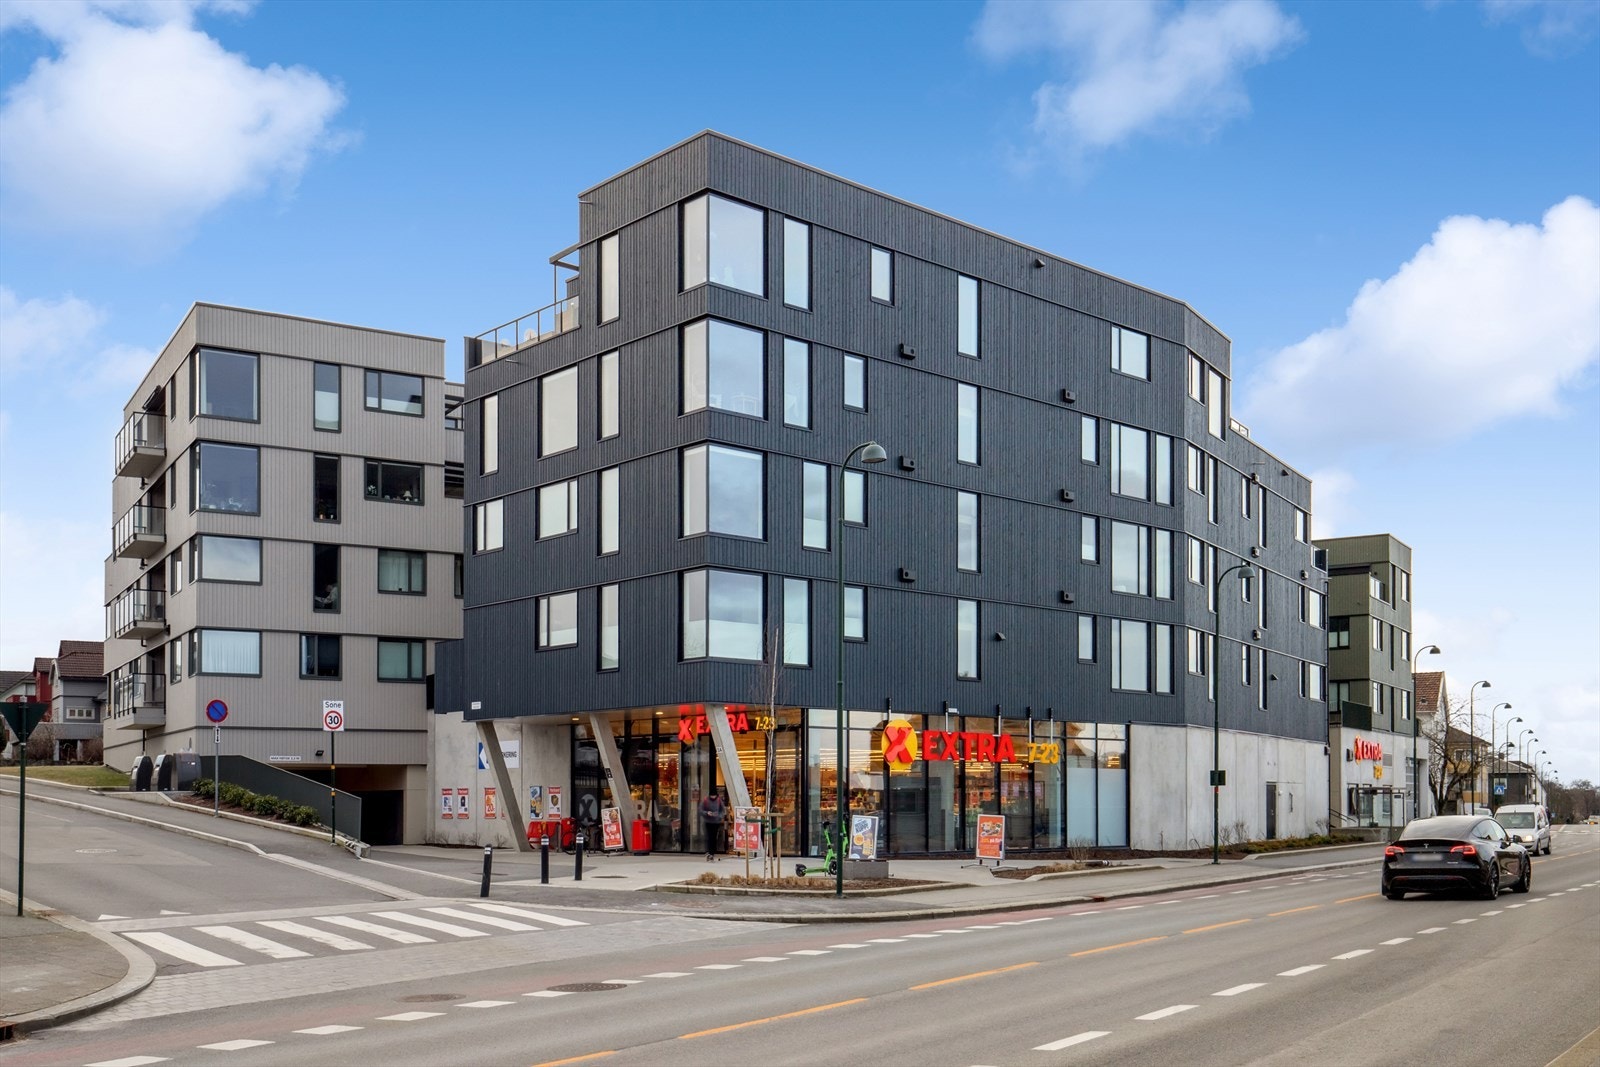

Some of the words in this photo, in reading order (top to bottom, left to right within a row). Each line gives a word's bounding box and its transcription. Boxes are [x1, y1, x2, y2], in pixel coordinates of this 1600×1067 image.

[328, 715, 339, 725] 30
[696, 712, 749, 733] ERA
[922, 730, 1017, 763] EXTRA
[1027, 743, 1061, 764] 7-23
